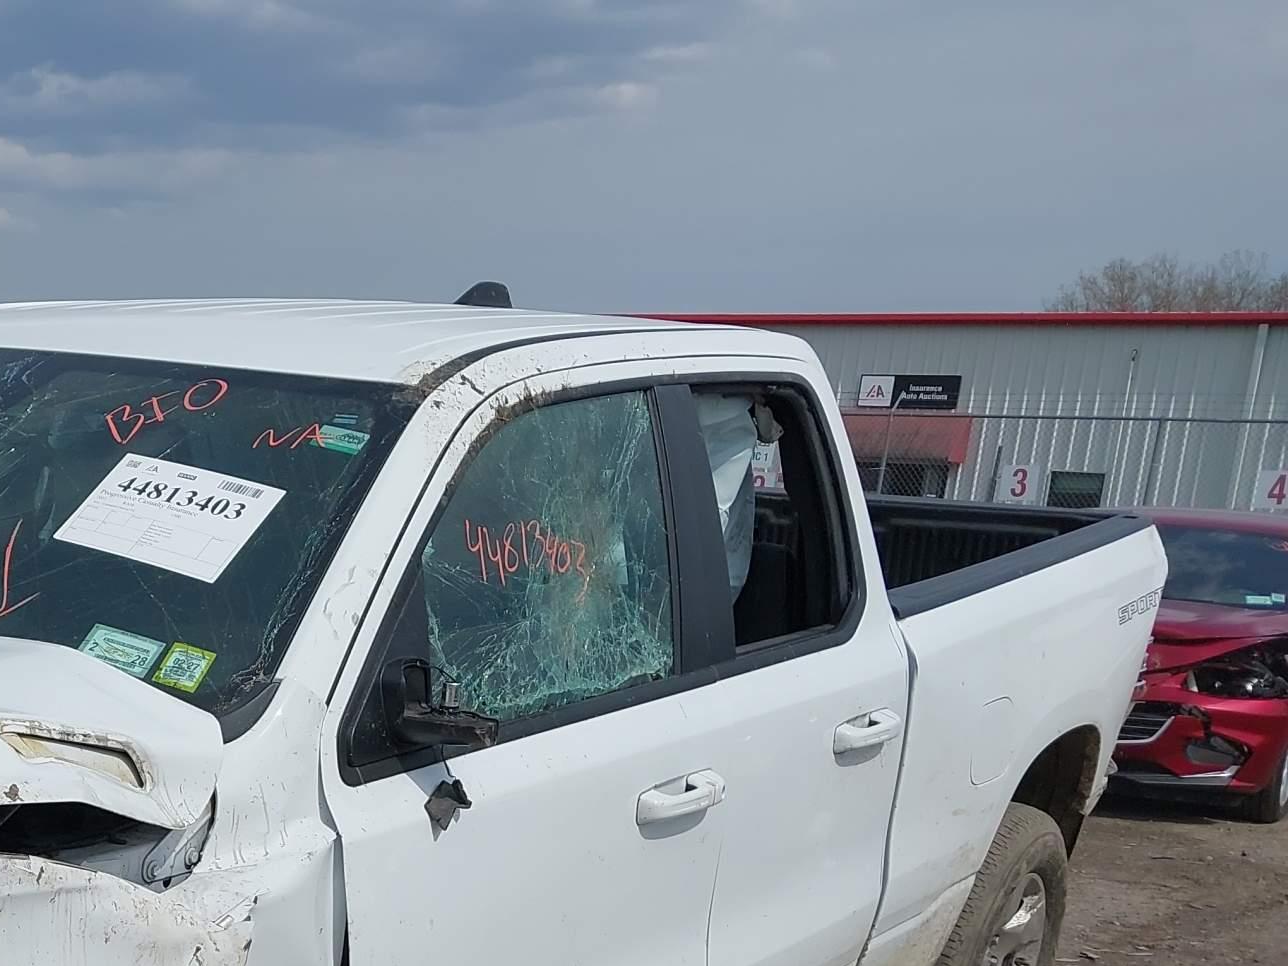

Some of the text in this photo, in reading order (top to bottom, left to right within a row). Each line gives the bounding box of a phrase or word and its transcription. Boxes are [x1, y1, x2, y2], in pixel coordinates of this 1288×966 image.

[902, 392, 948, 400] Auto Auctions
[909, 384, 942, 392] Insurance
[104, 378, 228, 444] BIO
[1010, 468, 1027, 497] 3
[1267, 474, 1287, 504] 4
[117, 476, 247, 520] 44813403
[131, 654, 148, 667] 28
